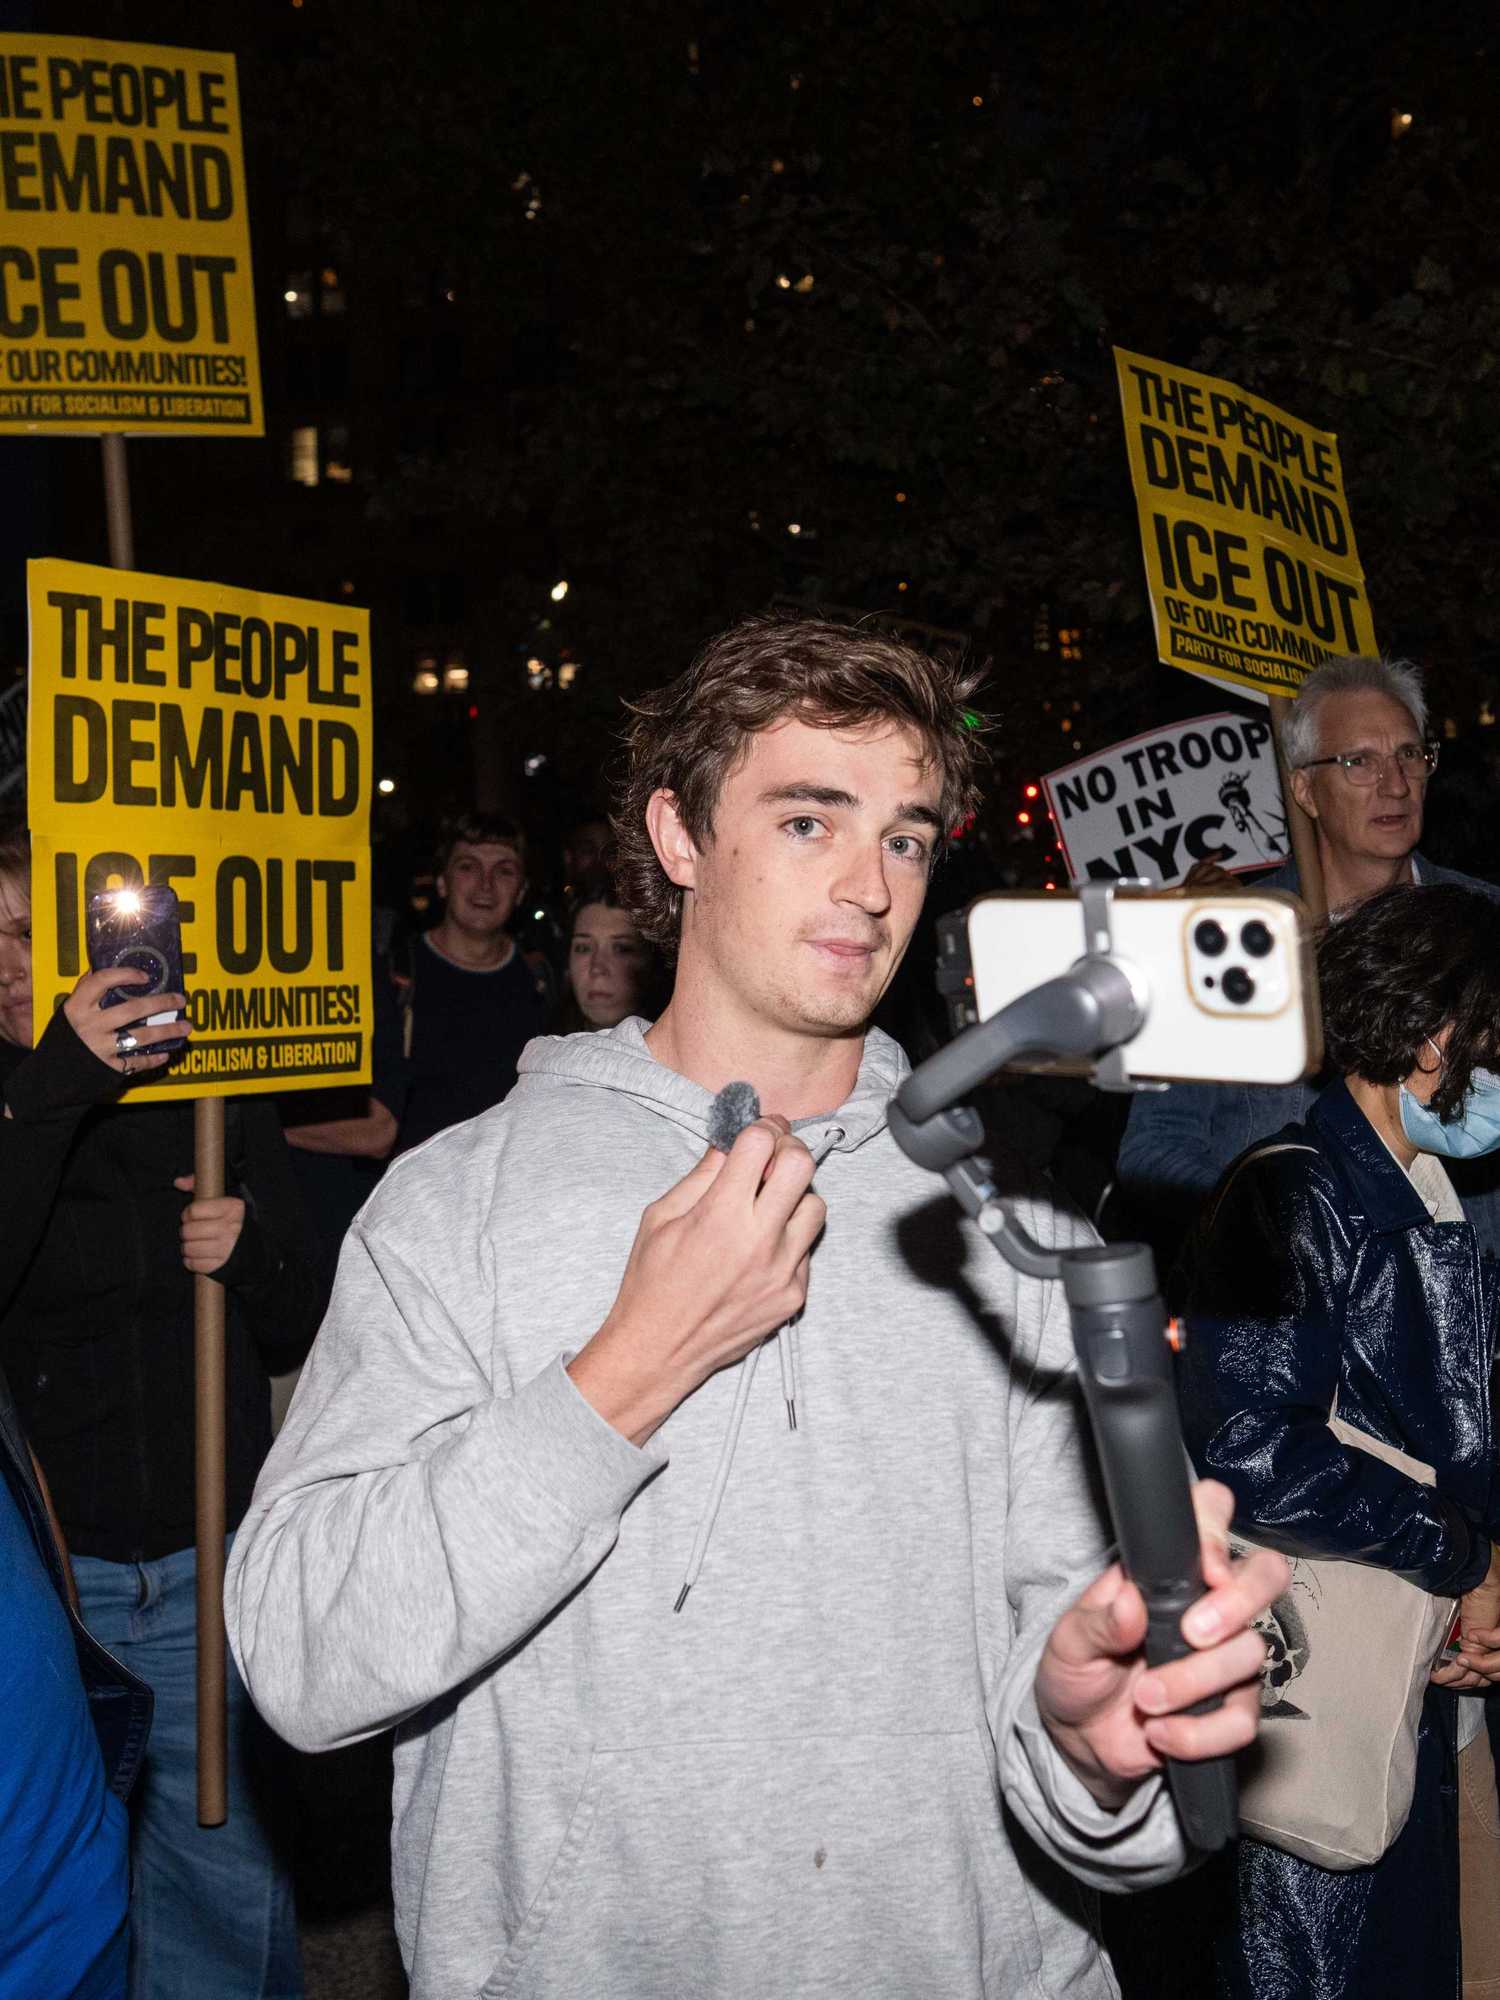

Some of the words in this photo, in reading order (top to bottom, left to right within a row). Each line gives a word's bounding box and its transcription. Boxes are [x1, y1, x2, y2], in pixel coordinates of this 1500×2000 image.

[48, 57, 229, 134] PEOPLE
[0, 131, 234, 222] EMAND
[0, 245, 85, 339] CE
[99, 249, 237, 344] OUT
[7, 350, 61, 383] OUR
[66, 350, 247, 387] COMMUNITIES!
[31, 394, 62, 416] FOR
[64, 394, 146, 417] SOCIALISM
[163, 396, 247, 420] LIBERATION
[1129, 364, 1208, 436] THE
[1209, 391, 1337, 492] PEOPLE
[1139, 422, 1348, 557] DEMAND
[1153, 513, 1257, 612] ICE
[1263, 546, 1360, 655] OUT
[1164, 596, 1191, 627] OF
[1193, 606, 1239, 644] OUR
[47, 591, 167, 686] THE
[177, 605, 361, 708] PEOPLE
[1175, 636, 1216, 661] PARTY
[1218, 650, 1243, 670] FOR
[1243, 657, 1303, 685] SOCIALIS
[53, 694, 360, 816] DEMAND
[1055, 765, 1117, 820] NO
[1085, 814, 1238, 881] NYC
[1116, 788, 1176, 837] IN
[216, 856, 356, 975] OUT
[257, 1047, 269, 1069] &
[272, 1041, 357, 1069] LIBERATION
